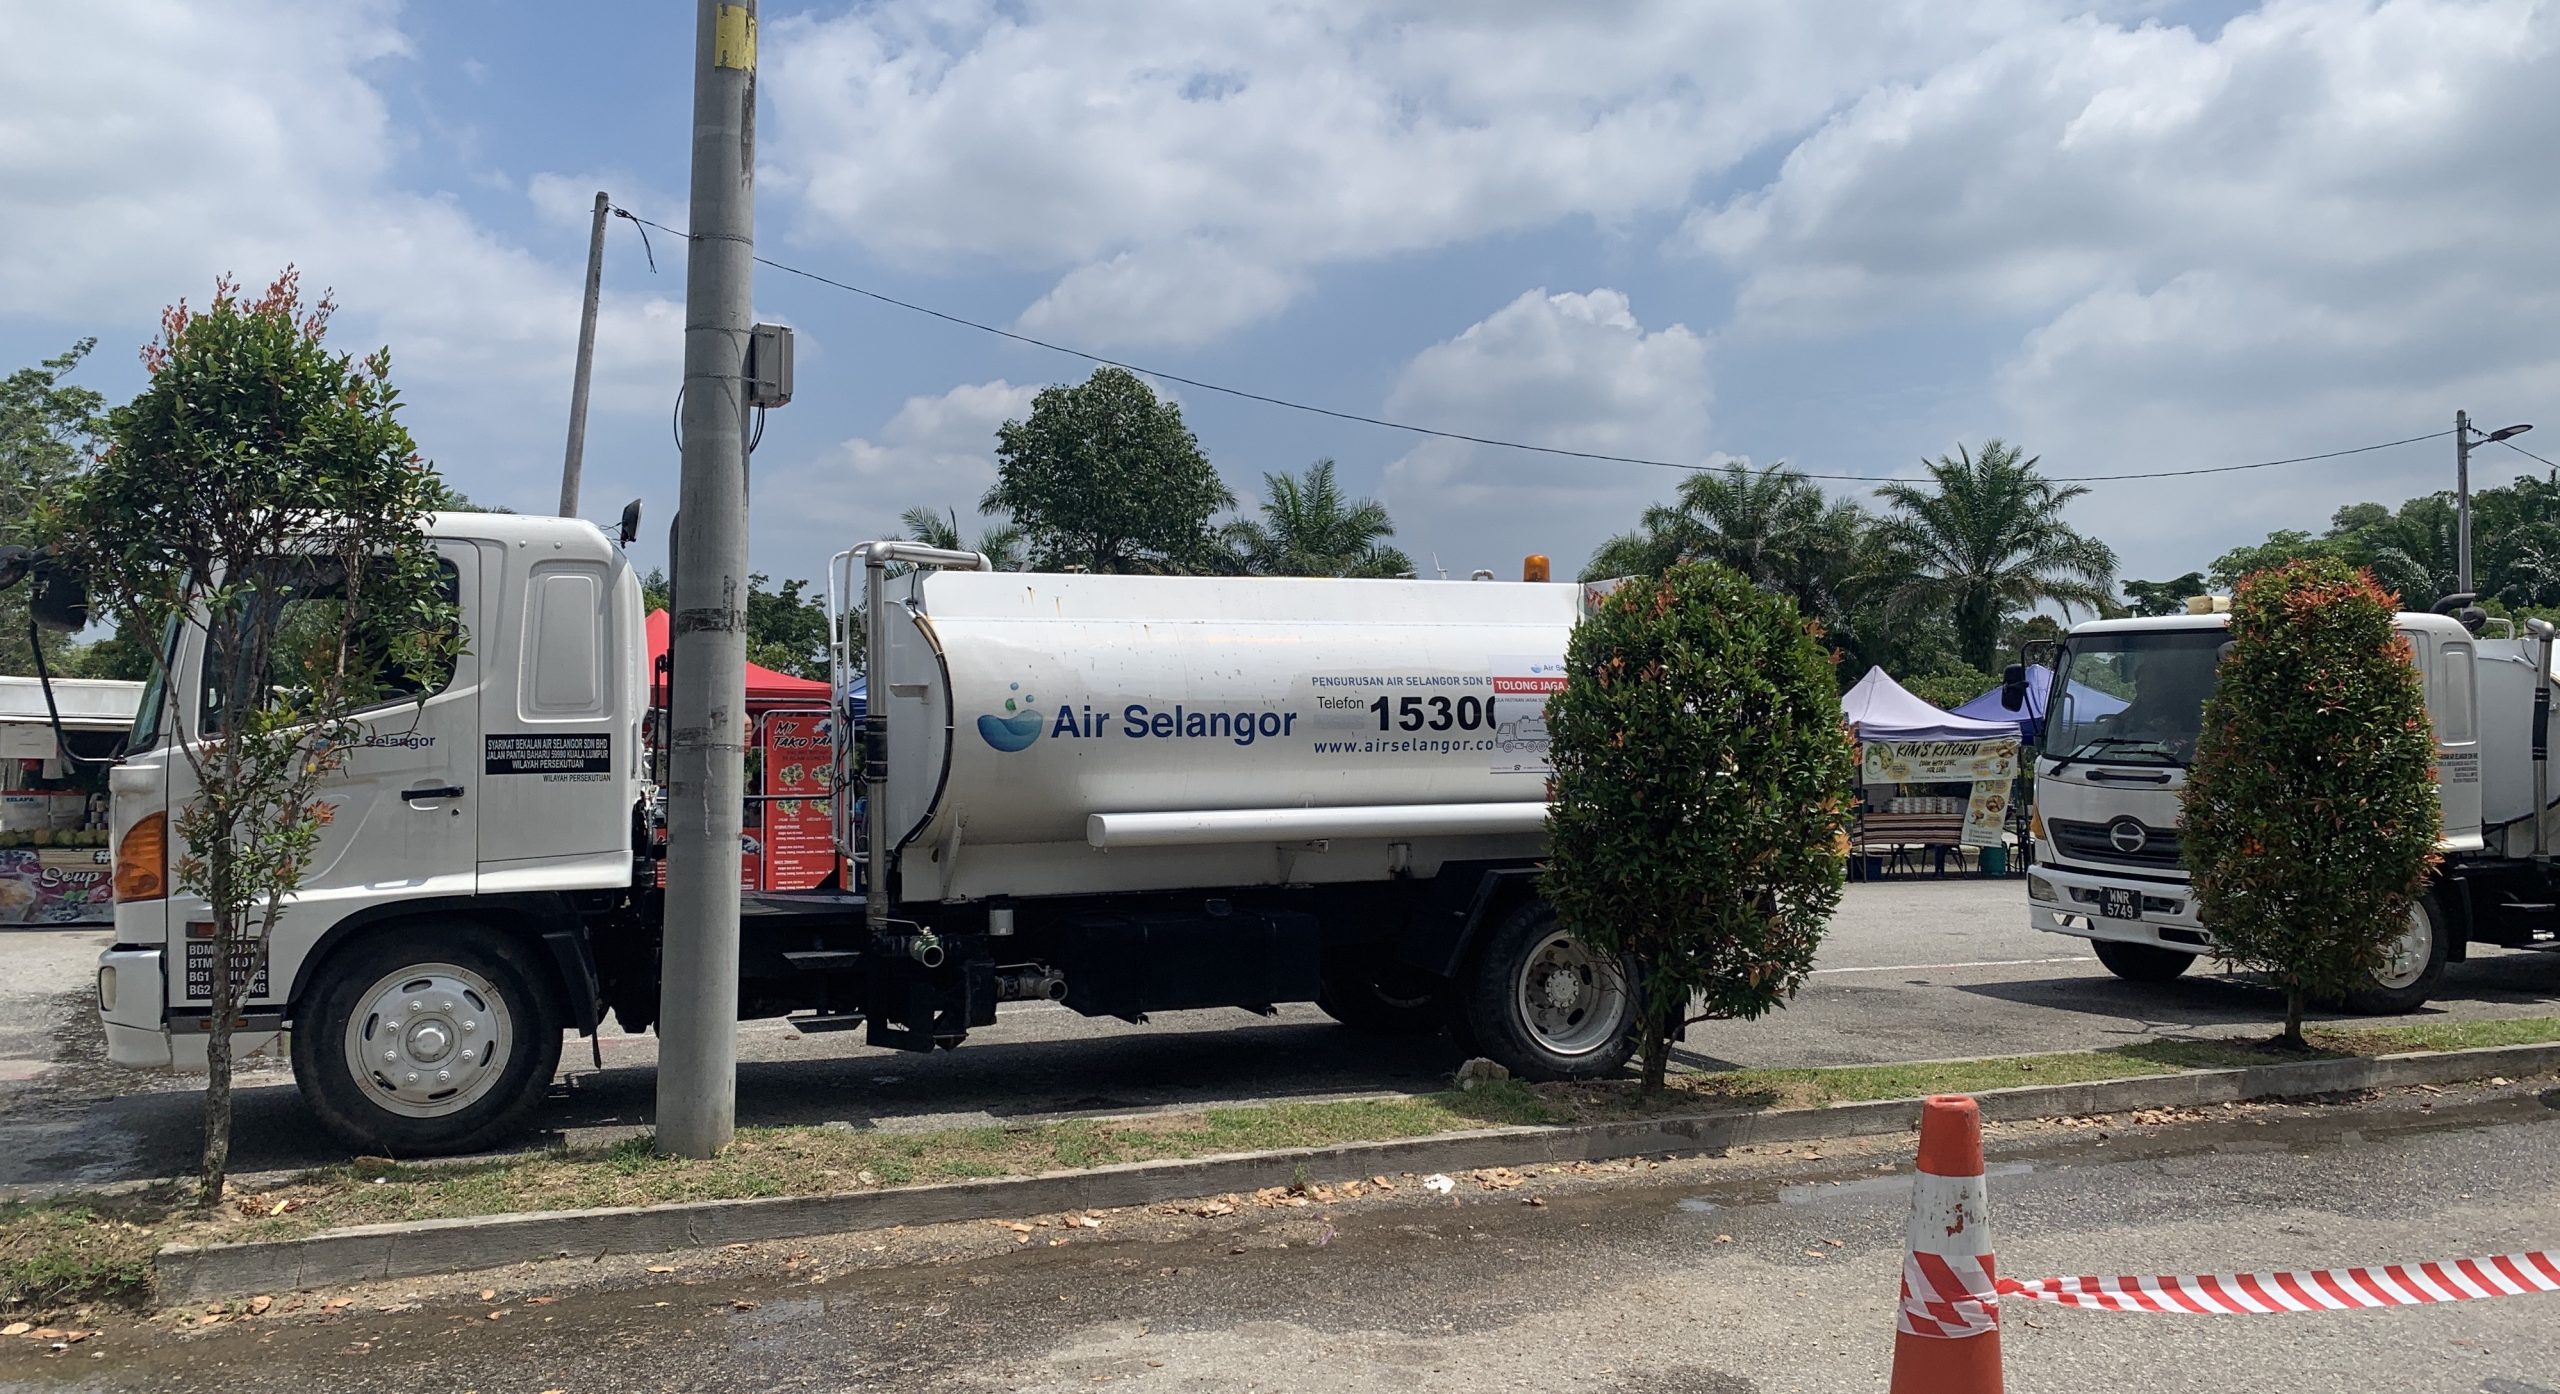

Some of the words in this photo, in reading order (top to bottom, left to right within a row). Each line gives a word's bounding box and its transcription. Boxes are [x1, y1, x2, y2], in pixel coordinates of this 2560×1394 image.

[1312, 676, 1384, 687] PENGURUSAN
[1387, 676, 1404, 686] AIR
[1406, 676, 1460, 686] SELANGOR
[1462, 676, 1483, 686] SDN
[1496, 680, 1538, 691] TOLONG
[1540, 681, 1565, 691] JAGA
[1316, 696, 1364, 709] Telefon
[775, 721, 799, 735] MY
[1051, 705, 1109, 738] Air
[1123, 704, 1297, 746] Selangor
[488, 739, 515, 750] SYARIKAT
[516, 739, 541, 750] BEKALAN
[543, 739, 552, 749] AIR
[553, 739, 582, 749] SELANGOR
[584, 739, 595, 749] SDN
[596, 739, 608, 749] BHD
[773, 736, 808, 751] TAKO
[1314, 738, 1494, 755] www.airselangor.co
[487, 750, 505, 760] JALAN
[506, 750, 526, 760] PANTAI
[527, 750, 550, 759] BAHARU
[567, 750, 585, 759] KUALA
[586, 750, 609, 759] LUMPUR
[1897, 742, 1931, 757] KIM'S
[1932, 743, 1980, 757] KITCHEN
[512, 760, 539, 769] WILAYAH
[540, 760, 584, 768] PERSEKUTUAN
[543, 774, 567, 782] WILAYAH
[569, 774, 610, 782] PERSEKUTUAN
[41, 866, 102, 889] Soup
[2110, 889, 2130, 904] WNR
[2107, 903, 2133, 918] 5749
[189, 945, 214, 955] BDM
[189, 958, 213, 968] BTM
[189, 971, 209, 981] BG1
[189, 984, 211, 995] BG2
